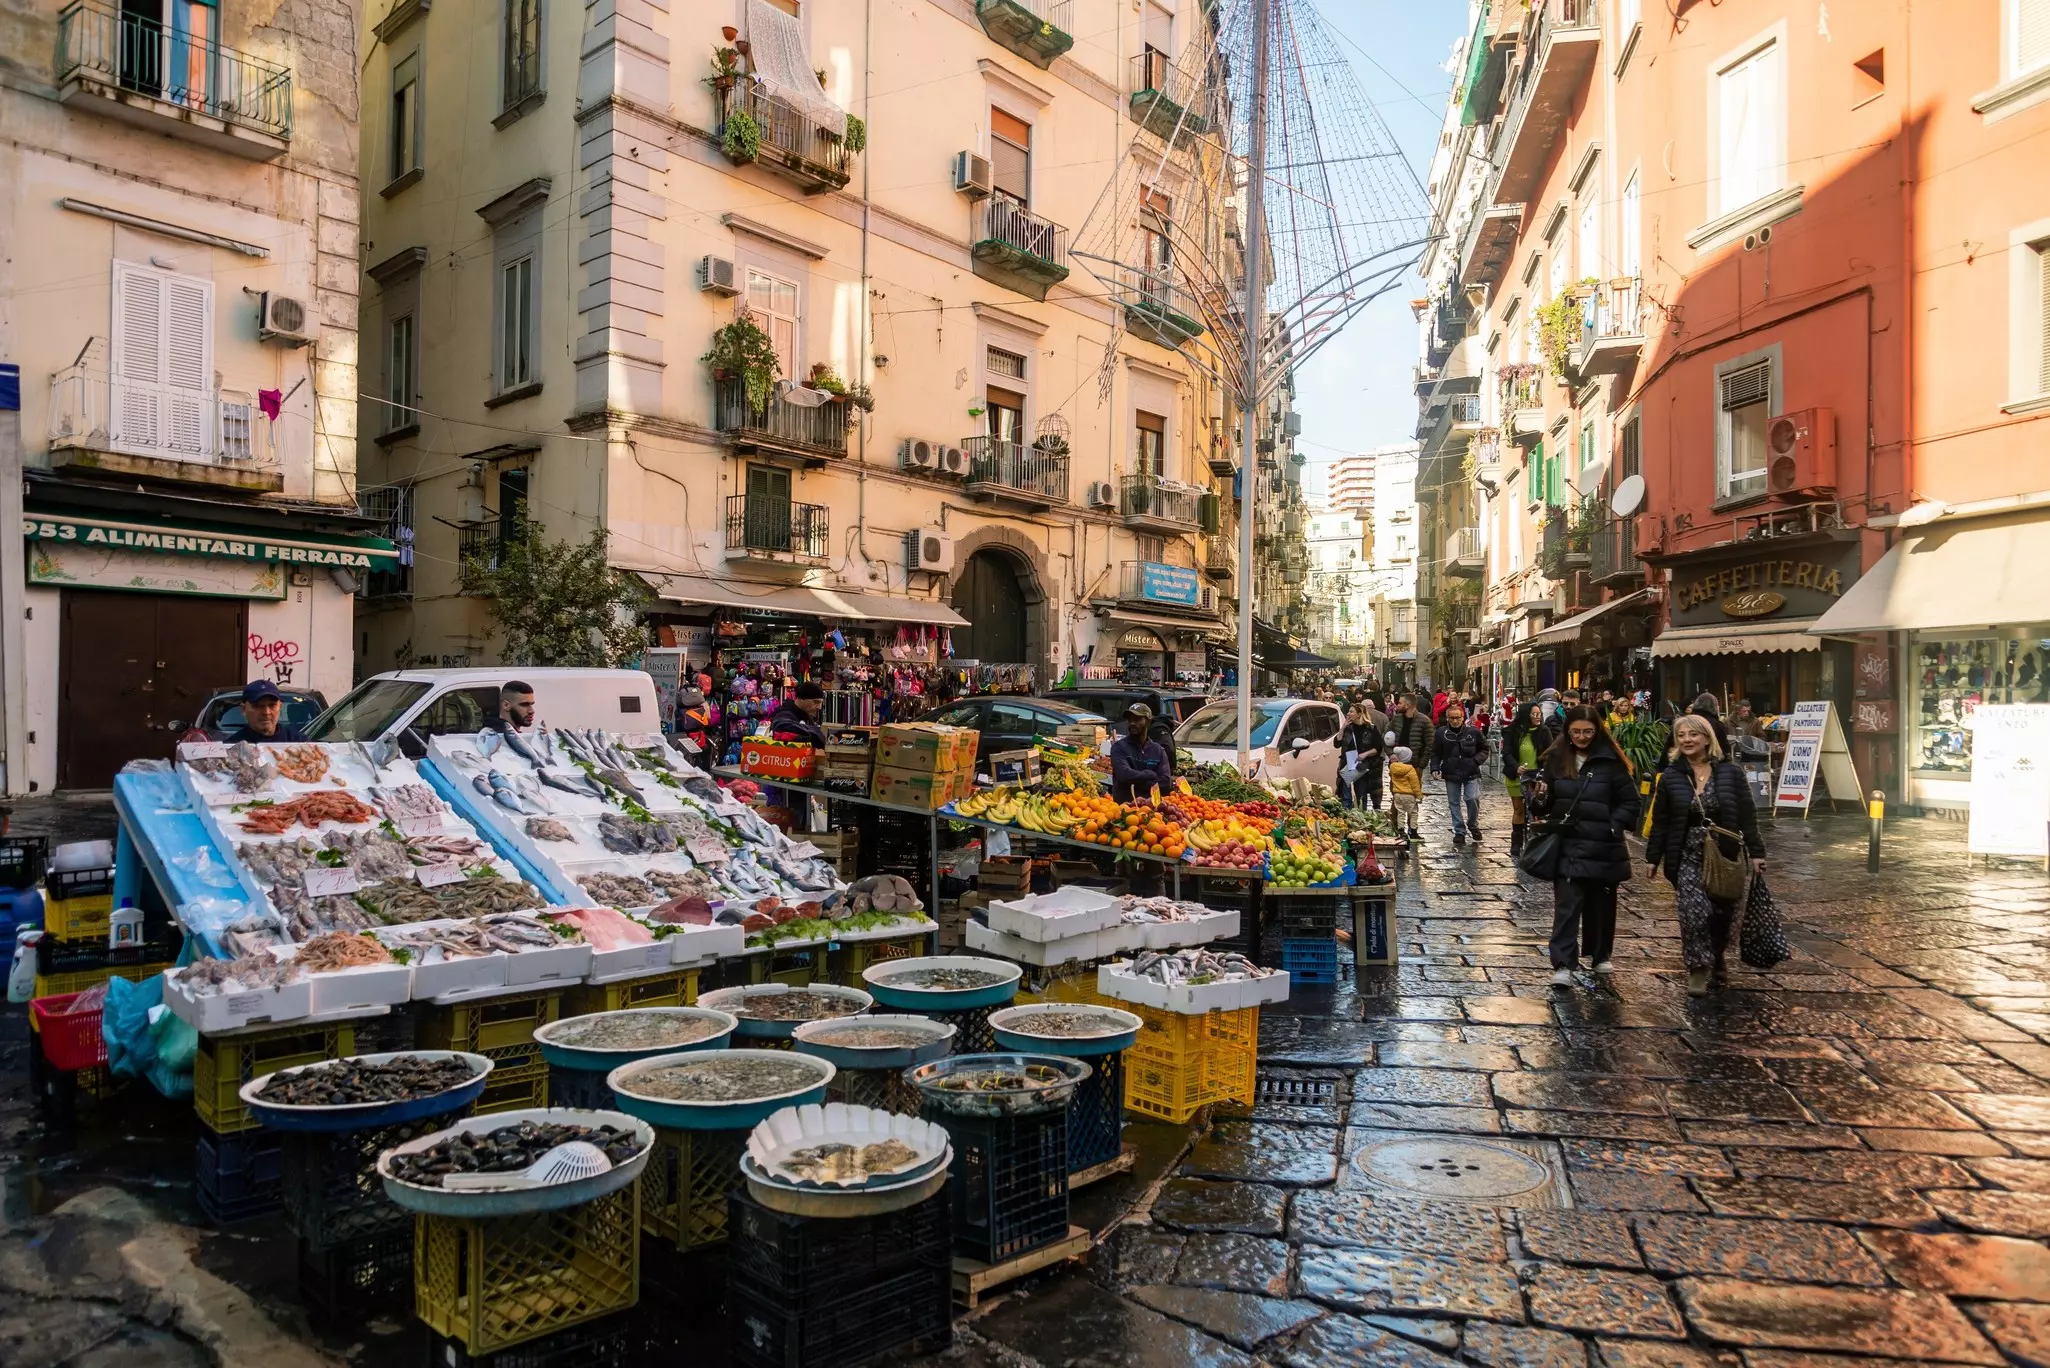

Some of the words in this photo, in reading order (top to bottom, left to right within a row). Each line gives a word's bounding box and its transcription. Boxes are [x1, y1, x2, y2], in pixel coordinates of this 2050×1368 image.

[87, 527, 255, 557] ALIMENTARI
[265, 546, 371, 568] FERRARA
[1676, 560, 1842, 613] CAFFETTERIA
[1125, 633, 1150, 644] Mister
[1797, 704, 1826, 713] CALZATURE
[1794, 719, 1823, 727] PANTOFOLE
[1793, 747, 1811, 756] UOMO
[762, 755, 791, 767] CITRUS
[1788, 761, 1809, 771] DONNA
[1783, 774, 1809, 786] BAMBINO
